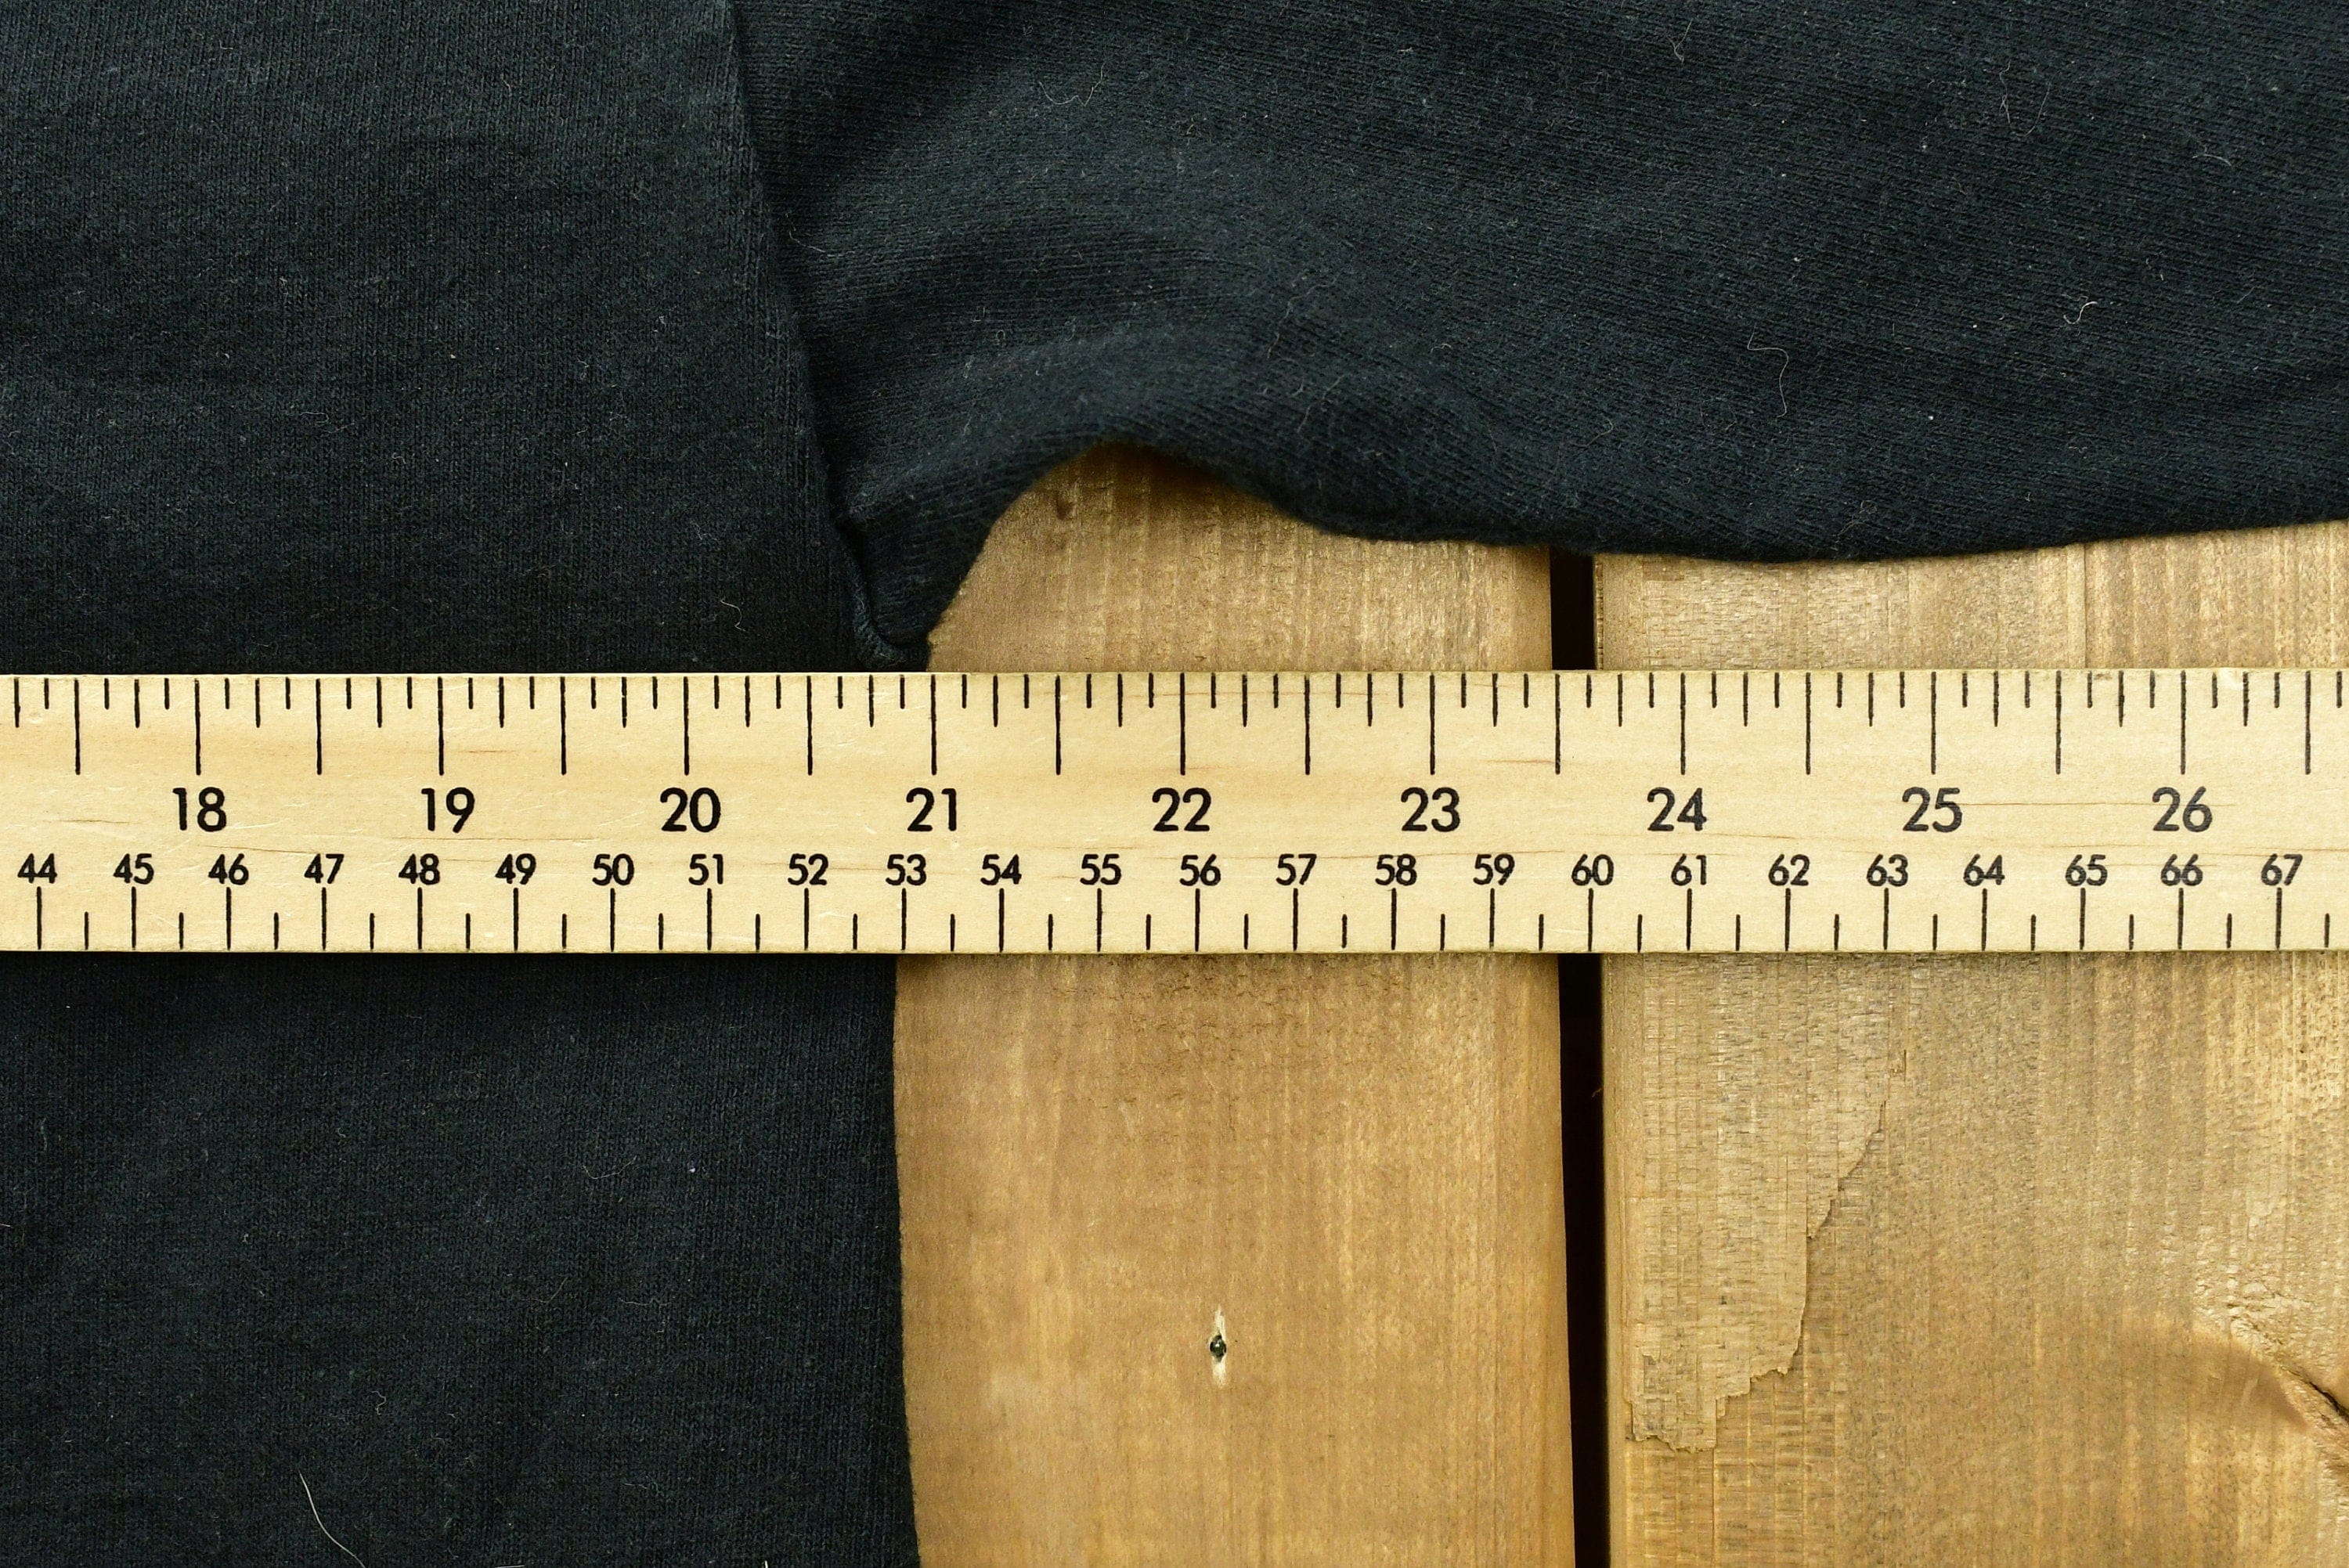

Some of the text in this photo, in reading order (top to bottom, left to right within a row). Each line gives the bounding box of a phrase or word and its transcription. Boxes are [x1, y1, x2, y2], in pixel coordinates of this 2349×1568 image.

[173, 787, 2212, 833] 18 19 20 21 22 23 24 25 26
[18, 853, 2302, 886] 44 45 46 47 48 49 50 51 52 53 54 55 56 57 58 59 60 61 62 63 64 65 66 67
